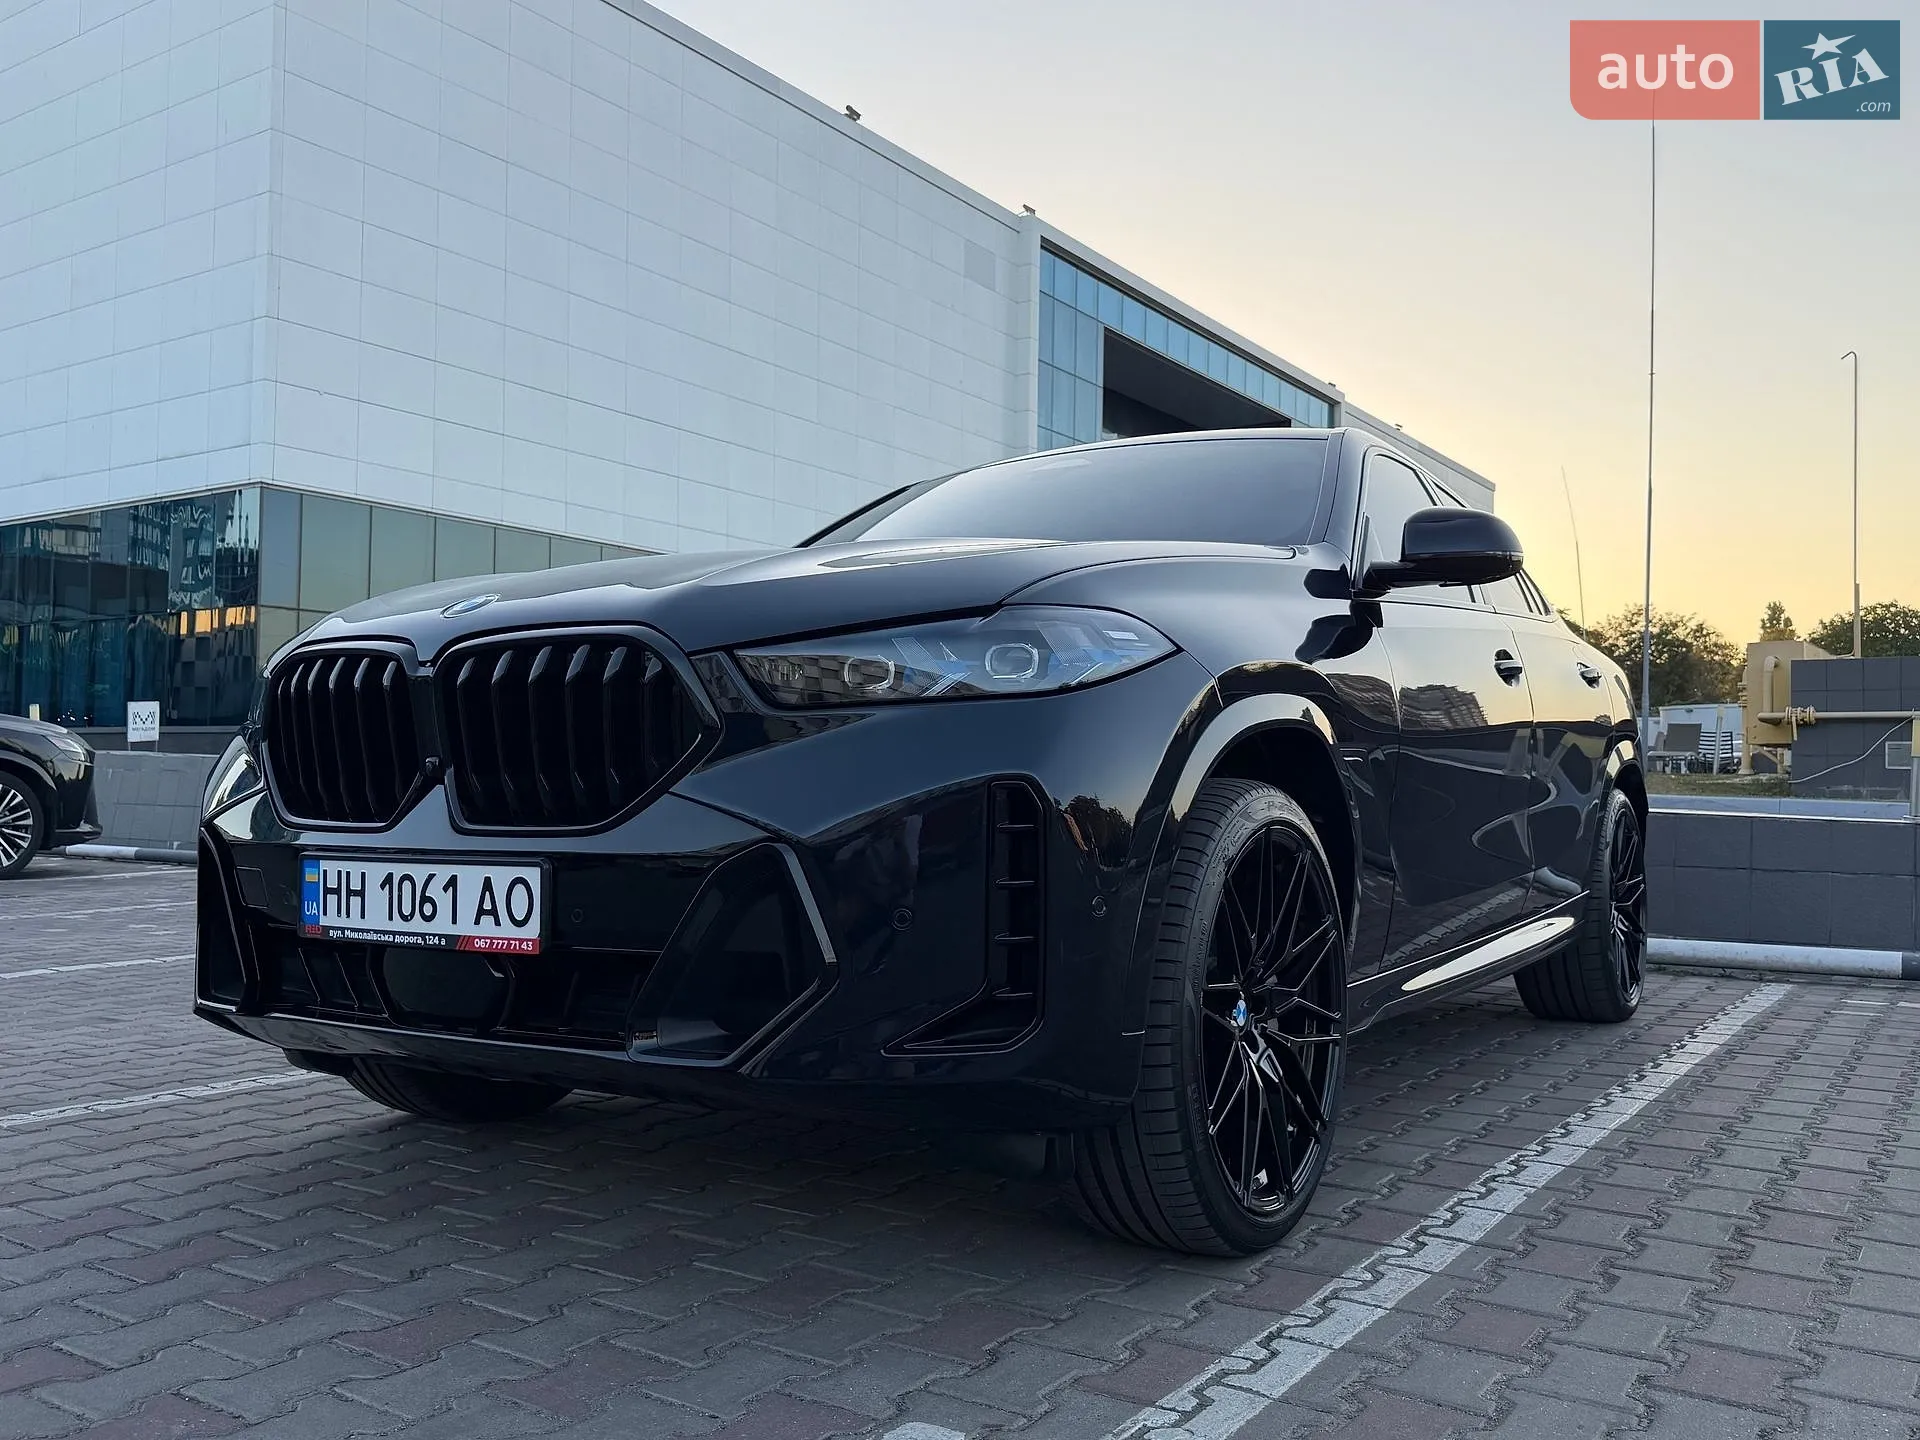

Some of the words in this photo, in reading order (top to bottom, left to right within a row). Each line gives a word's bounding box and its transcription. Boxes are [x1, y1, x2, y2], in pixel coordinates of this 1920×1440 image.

[322, 868, 367, 920] HH
[379, 871, 459, 925] 1061
[473, 875, 535, 928] AO
[304, 901, 319, 916] UA
[329, 930, 343, 938] вул.
[395, 935, 424, 945] дорога,
[425, 936, 439, 944] 124
[474, 939, 490, 948] 067
[492, 940, 508, 949] 777
[509, 941, 519, 950] 71
[521, 942, 533, 951] 43
